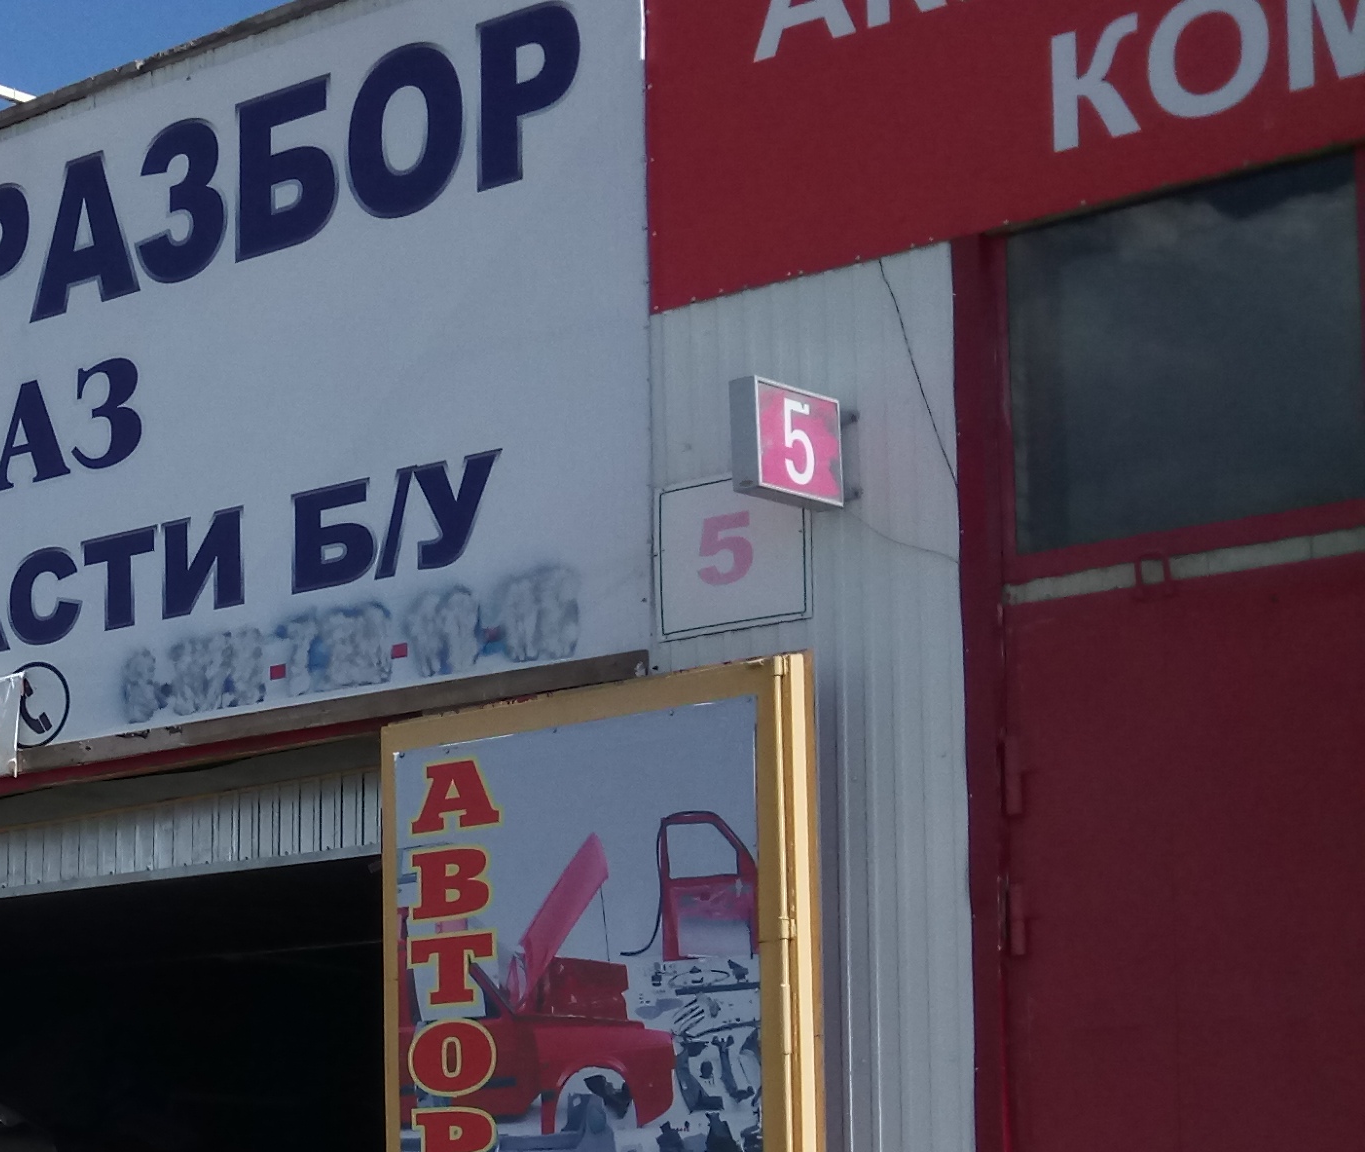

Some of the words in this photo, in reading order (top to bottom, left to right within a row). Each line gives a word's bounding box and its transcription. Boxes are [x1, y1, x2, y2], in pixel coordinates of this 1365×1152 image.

[783, 399, 816, 485] 5
[291, 448, 503, 594] Б/У
[697, 511, 755, 587] 5
